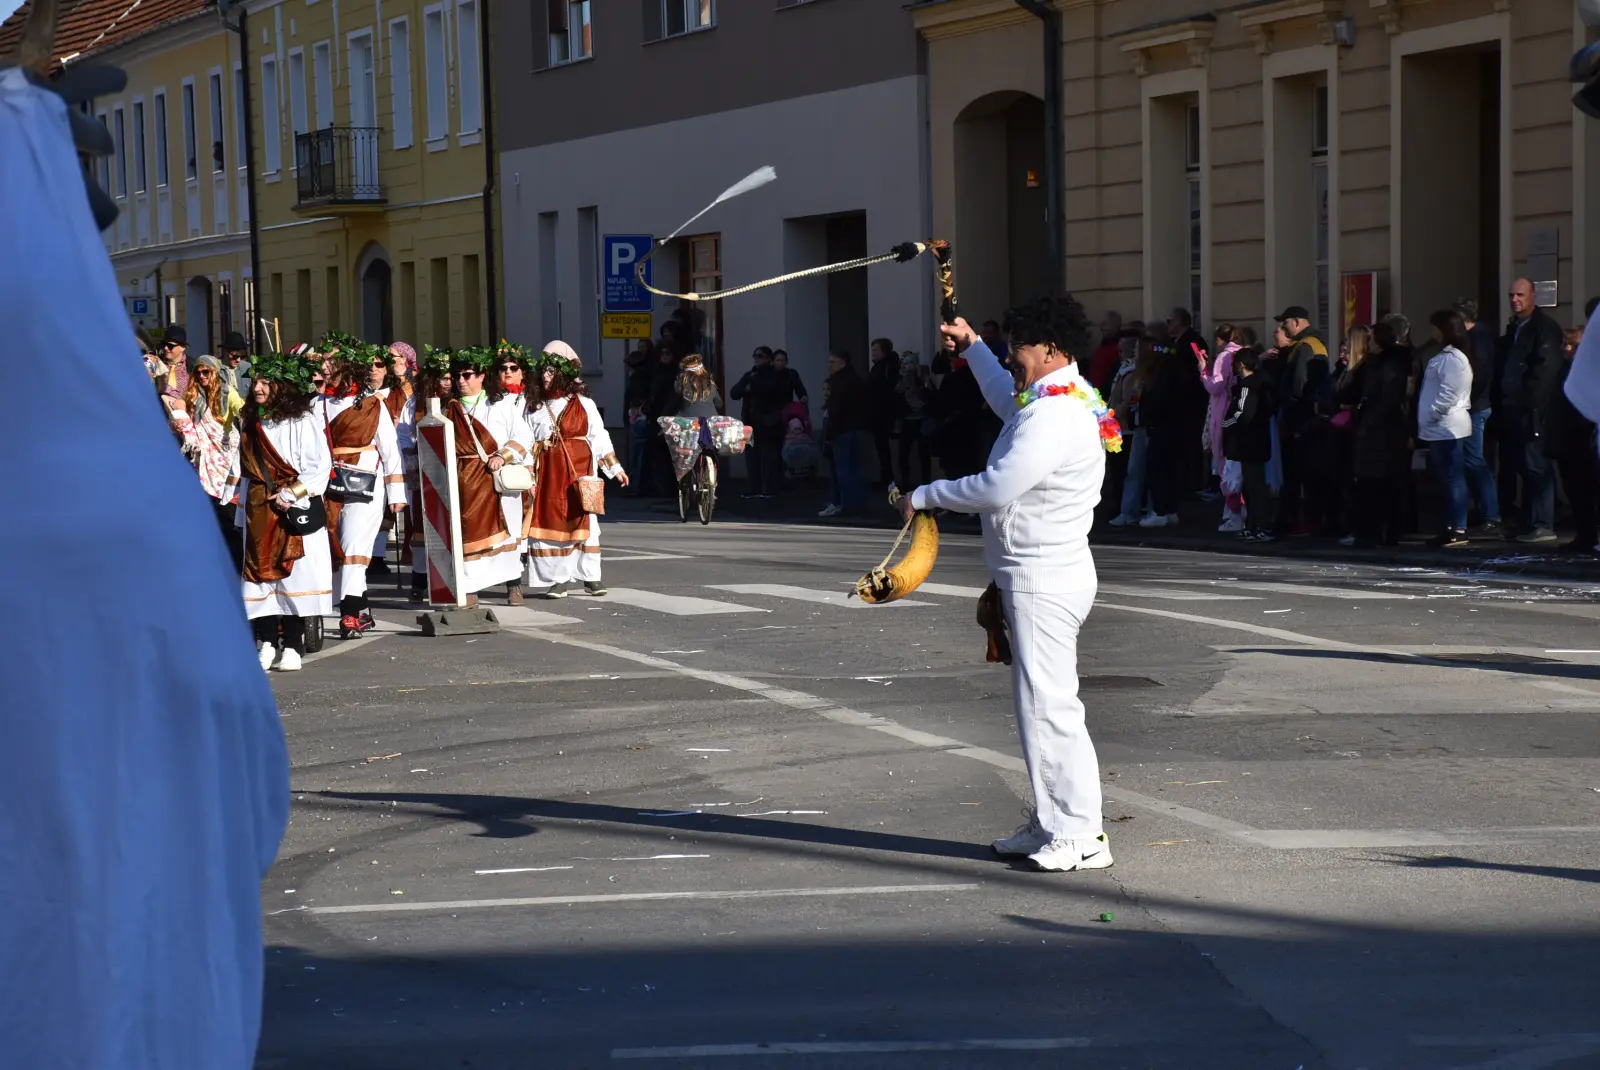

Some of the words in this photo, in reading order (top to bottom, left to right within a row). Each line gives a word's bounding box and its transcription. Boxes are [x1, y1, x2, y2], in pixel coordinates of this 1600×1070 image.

[612, 243, 636, 275] P
[136, 302, 145, 312] P
[626, 326, 631, 334] 2
